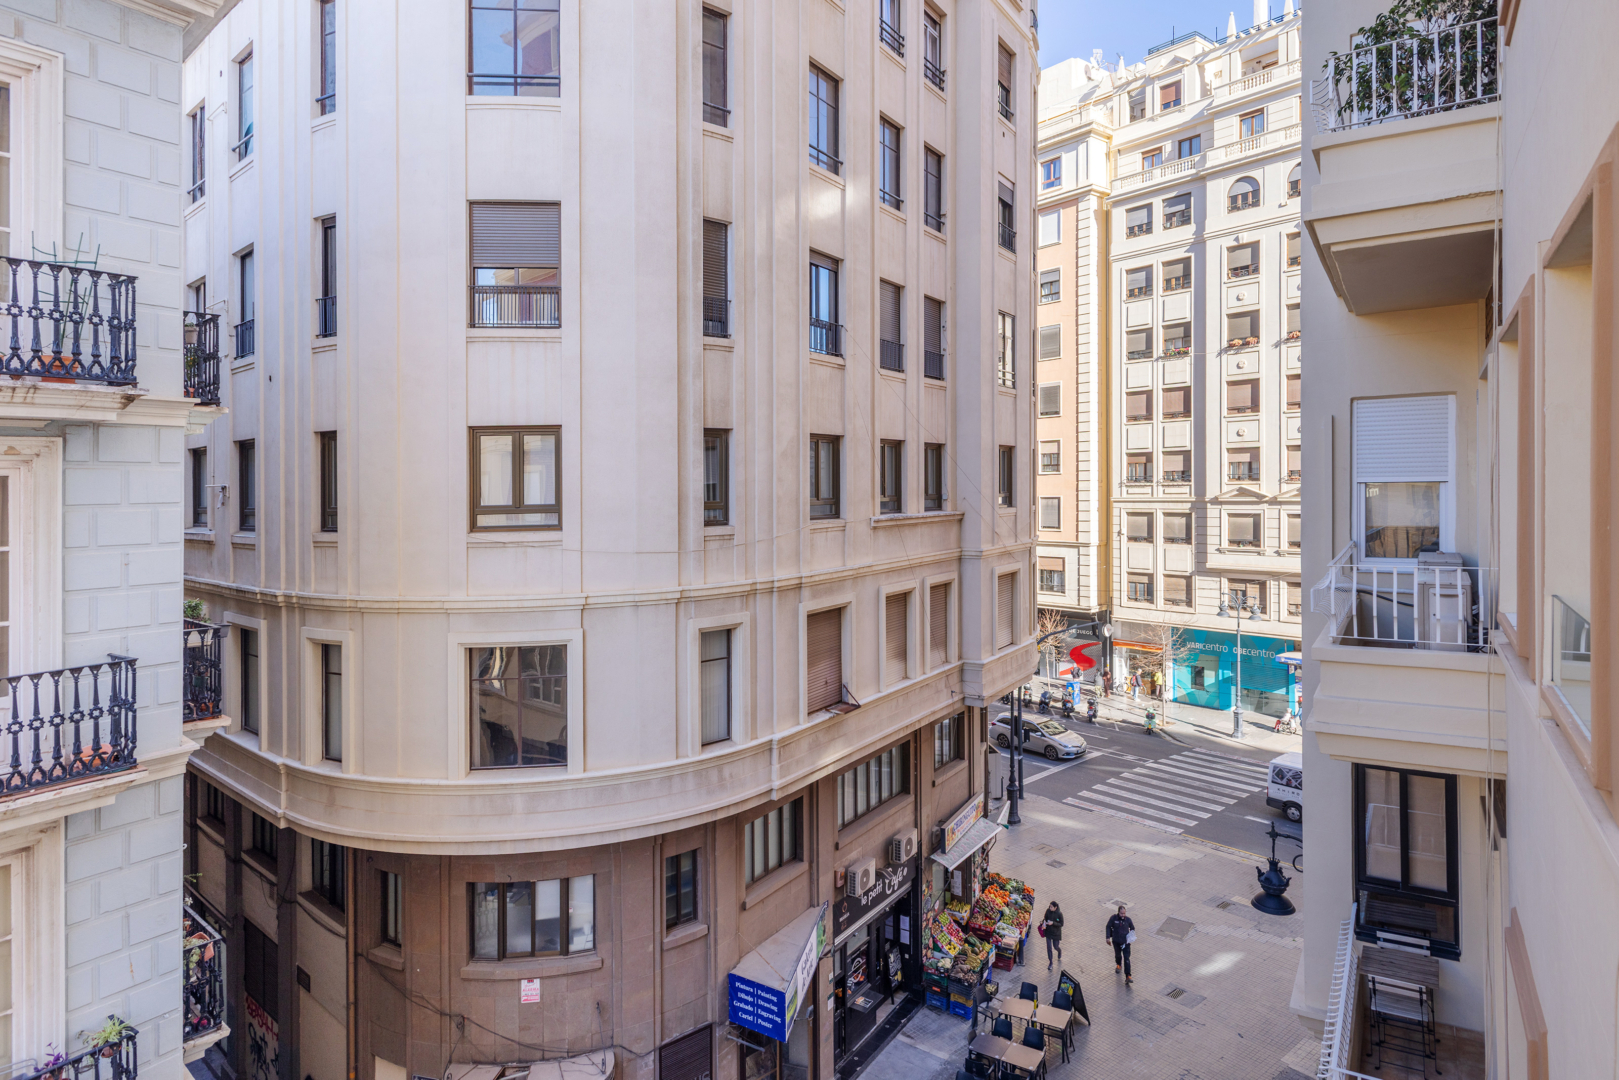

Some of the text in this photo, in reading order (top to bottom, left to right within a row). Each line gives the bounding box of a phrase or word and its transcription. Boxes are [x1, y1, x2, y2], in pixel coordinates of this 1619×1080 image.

[869, 879, 883, 905] petit
[735, 982, 777, 1002] Pintura Painting
[738, 992, 778, 1012] Dibujo Drawing
[734, 1000, 781, 1023] Grabado Engraving
[739, 1012, 773, 1028] Cartel Poster
